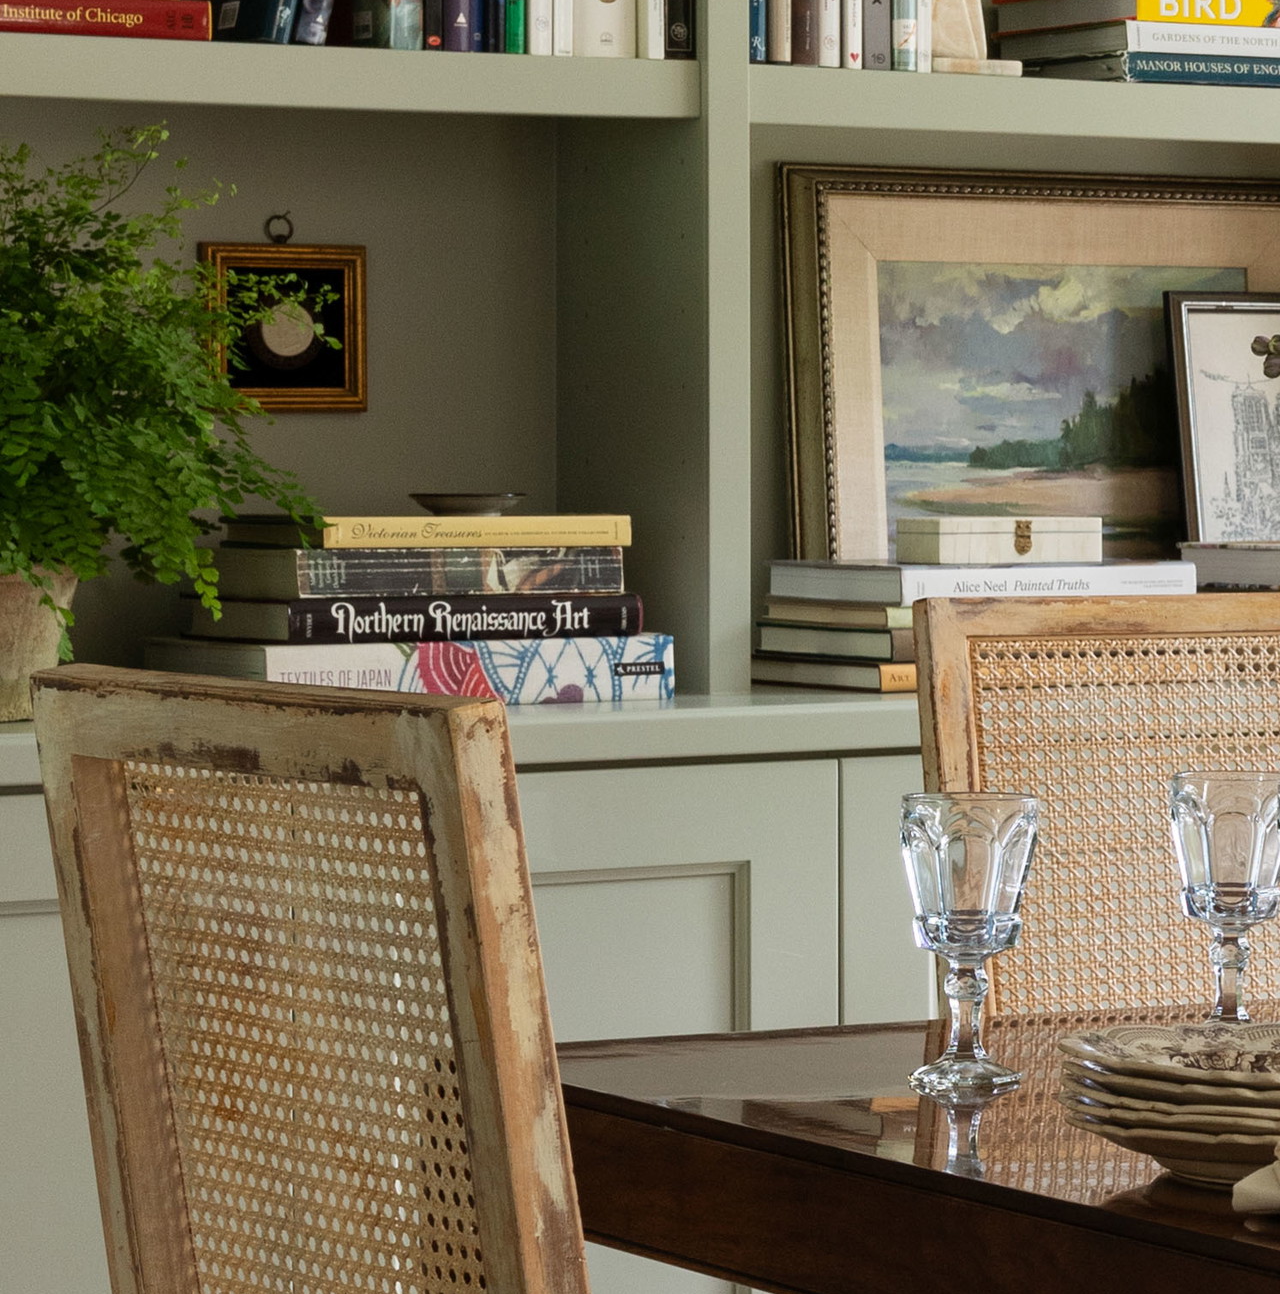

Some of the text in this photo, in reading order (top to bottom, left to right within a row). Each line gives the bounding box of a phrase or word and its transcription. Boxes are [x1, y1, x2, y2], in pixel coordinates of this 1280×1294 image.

[3, 4, 144, 28] Institute of Chicago
[1152, 32, 1202, 44] GARDENS
[1202, 34, 1217, 45] OF
[1219, 36, 1241, 46] THE
[1244, 36, 1278, 48] NORTH
[1136, 60, 1182, 73] MANOR
[1184, 61, 1232, 74] HOUSES
[1233, 63, 1252, 74] OF
[351, 522, 483, 541] Victorian Treasures
[953, 578, 1090, 593] Alice Neel Painted Truths
[331, 599, 591, 643] Northern Renaissance Art
[625, 664, 661, 674] PRESTEL
[338, 670, 355, 688] OF
[355, 669, 392, 689] JAPAN
[888, 672, 911, 684] ART
